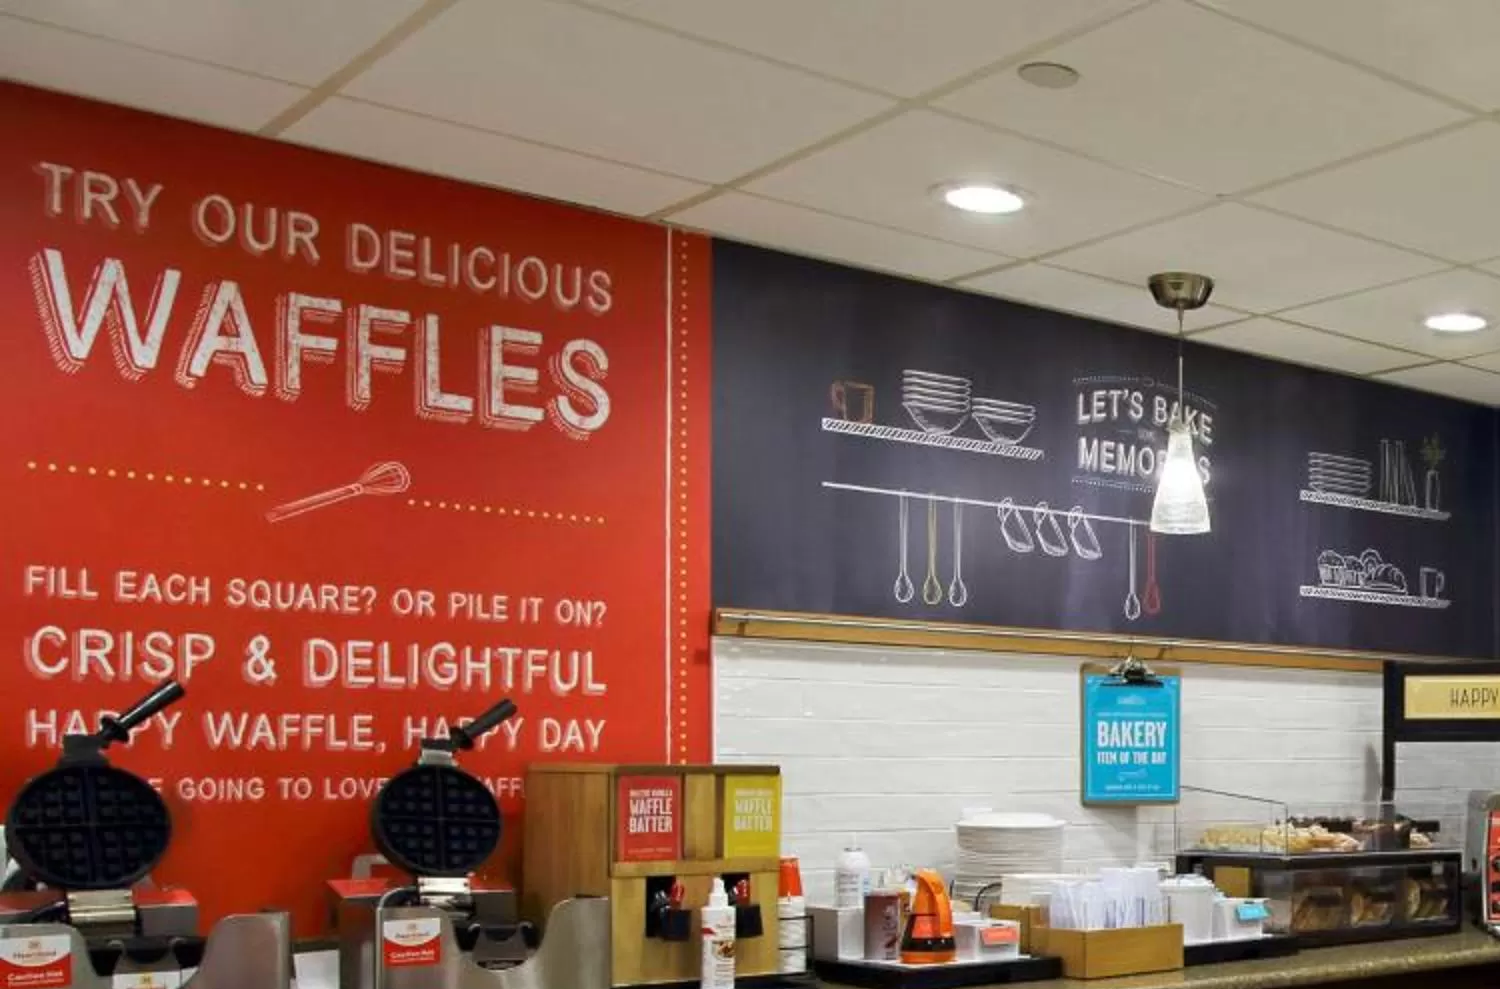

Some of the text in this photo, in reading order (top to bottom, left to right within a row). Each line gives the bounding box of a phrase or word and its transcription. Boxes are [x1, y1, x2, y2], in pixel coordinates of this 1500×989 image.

[38, 161, 613, 314] TRY OUR DELICIOUS
[29, 247, 612, 440] WAFFLES
[1077, 389, 1214, 446] LET'S BAKE
[1077, 436, 1213, 487] MEMOS
[24, 565, 608, 629] FILL EACH SQUARE? OR PILE IT ON?
[28, 625, 608, 696] CRISP & DELIGHTFUL
[1449, 687, 1500, 708] HAPPY
[206, 711, 387, 754] WAFFLE,
[540, 718, 607, 752] DAY
[1097, 720, 1167, 748] BAKERY
[177, 776, 265, 800] GOING
[278, 778, 313, 800] TO
[629, 798, 673, 816] WAFFLE
[629, 815, 673, 833] BATTER
